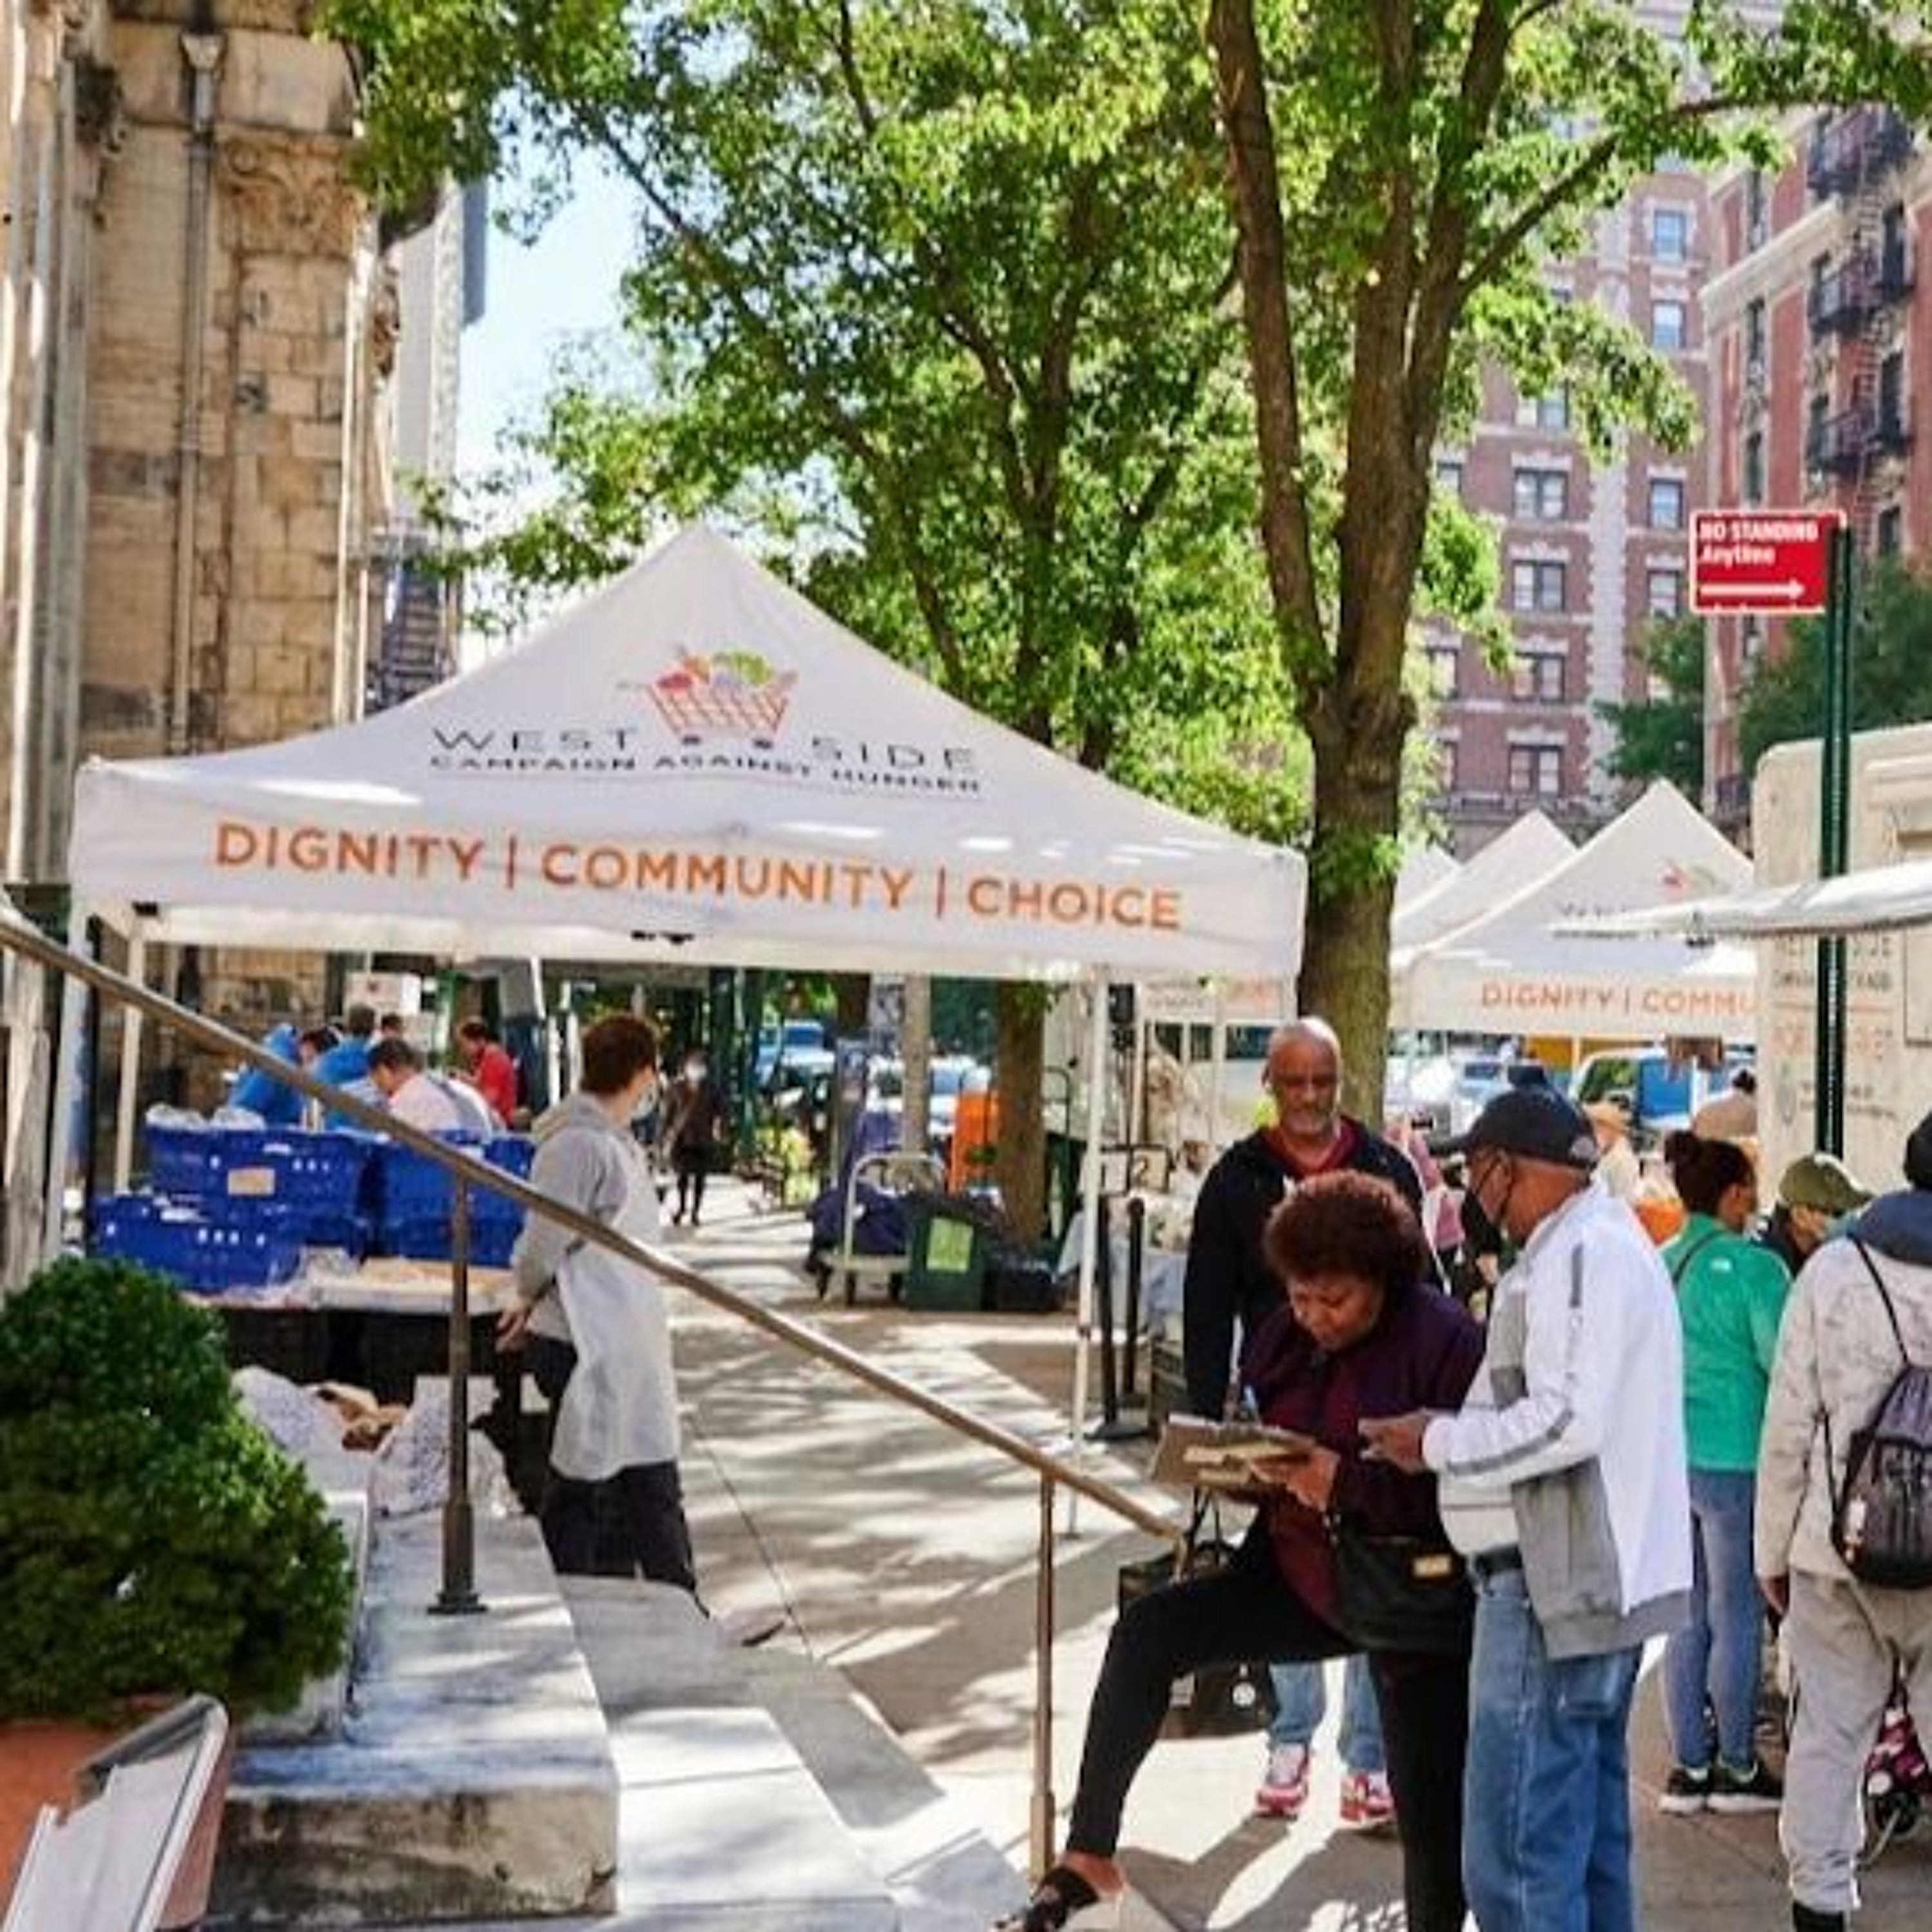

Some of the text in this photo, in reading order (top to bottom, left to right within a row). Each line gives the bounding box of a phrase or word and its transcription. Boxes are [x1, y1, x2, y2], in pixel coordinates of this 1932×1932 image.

[1700, 520, 1819, 542] NO STANDING
[1700, 544, 1776, 569] Anytime
[432, 727, 974, 770] WEST SIDE
[430, 754, 981, 793] CAMPAIGN AGAINST HUNGER
[215, 822, 484, 881] DIGNITY
[540, 842, 915, 910] COMMUNITY
[968, 876, 1182, 931] CHOICE
[1481, 982, 1611, 1011] DIGNITY
